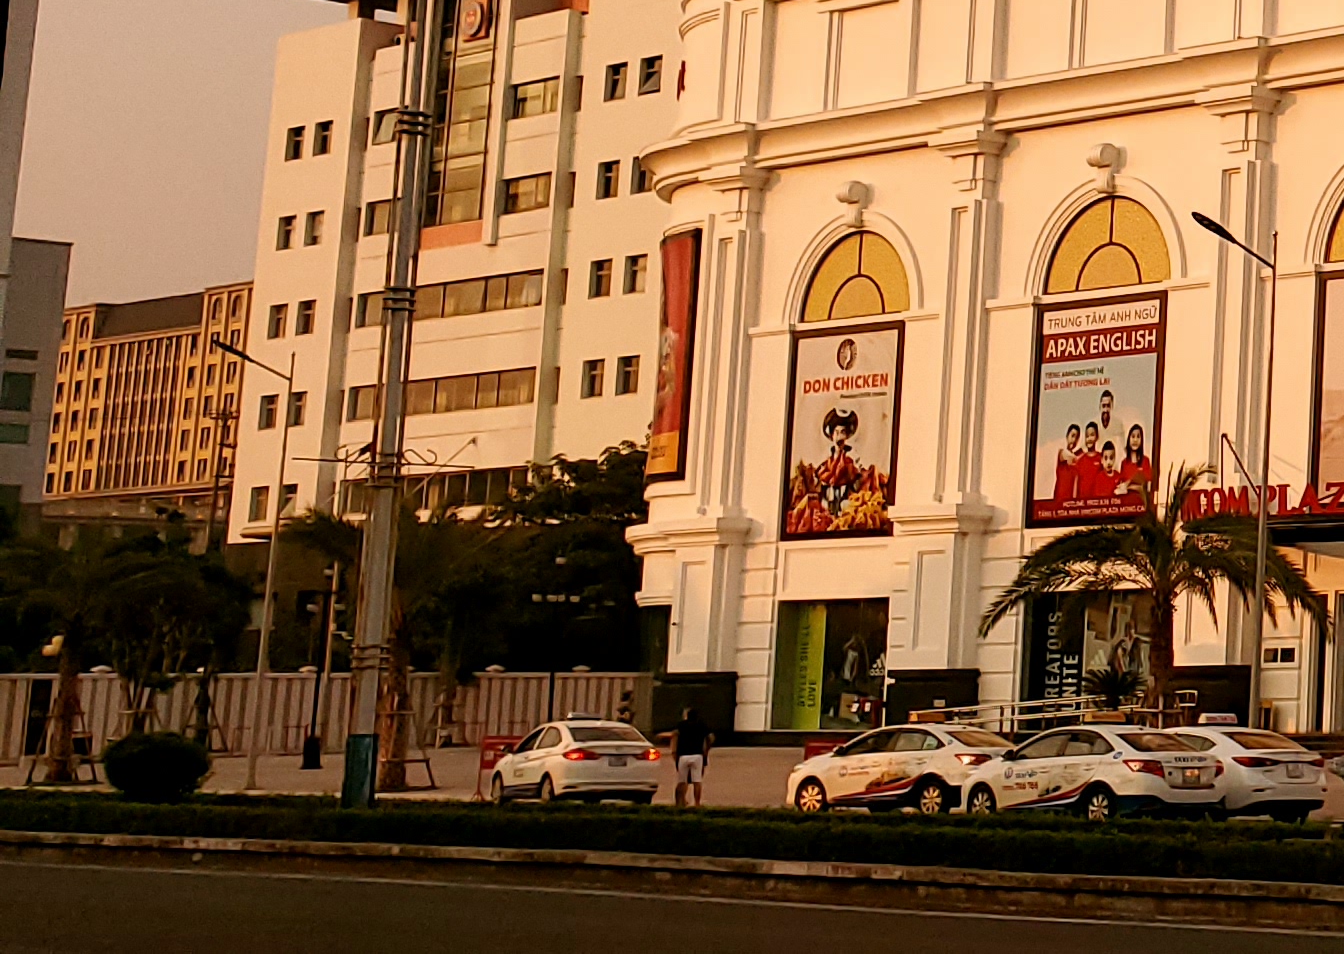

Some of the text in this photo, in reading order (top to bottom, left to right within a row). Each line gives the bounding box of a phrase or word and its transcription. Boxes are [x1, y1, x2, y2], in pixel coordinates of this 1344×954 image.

[1048, 316, 1083, 330] TRUNG
[1085, 312, 1107, 327] TÂM
[1110, 309, 1132, 324] ANH
[1046, 329, 1157, 358] APAX ENGLISH
[803, 373, 889, 394] DON CHICKEN
